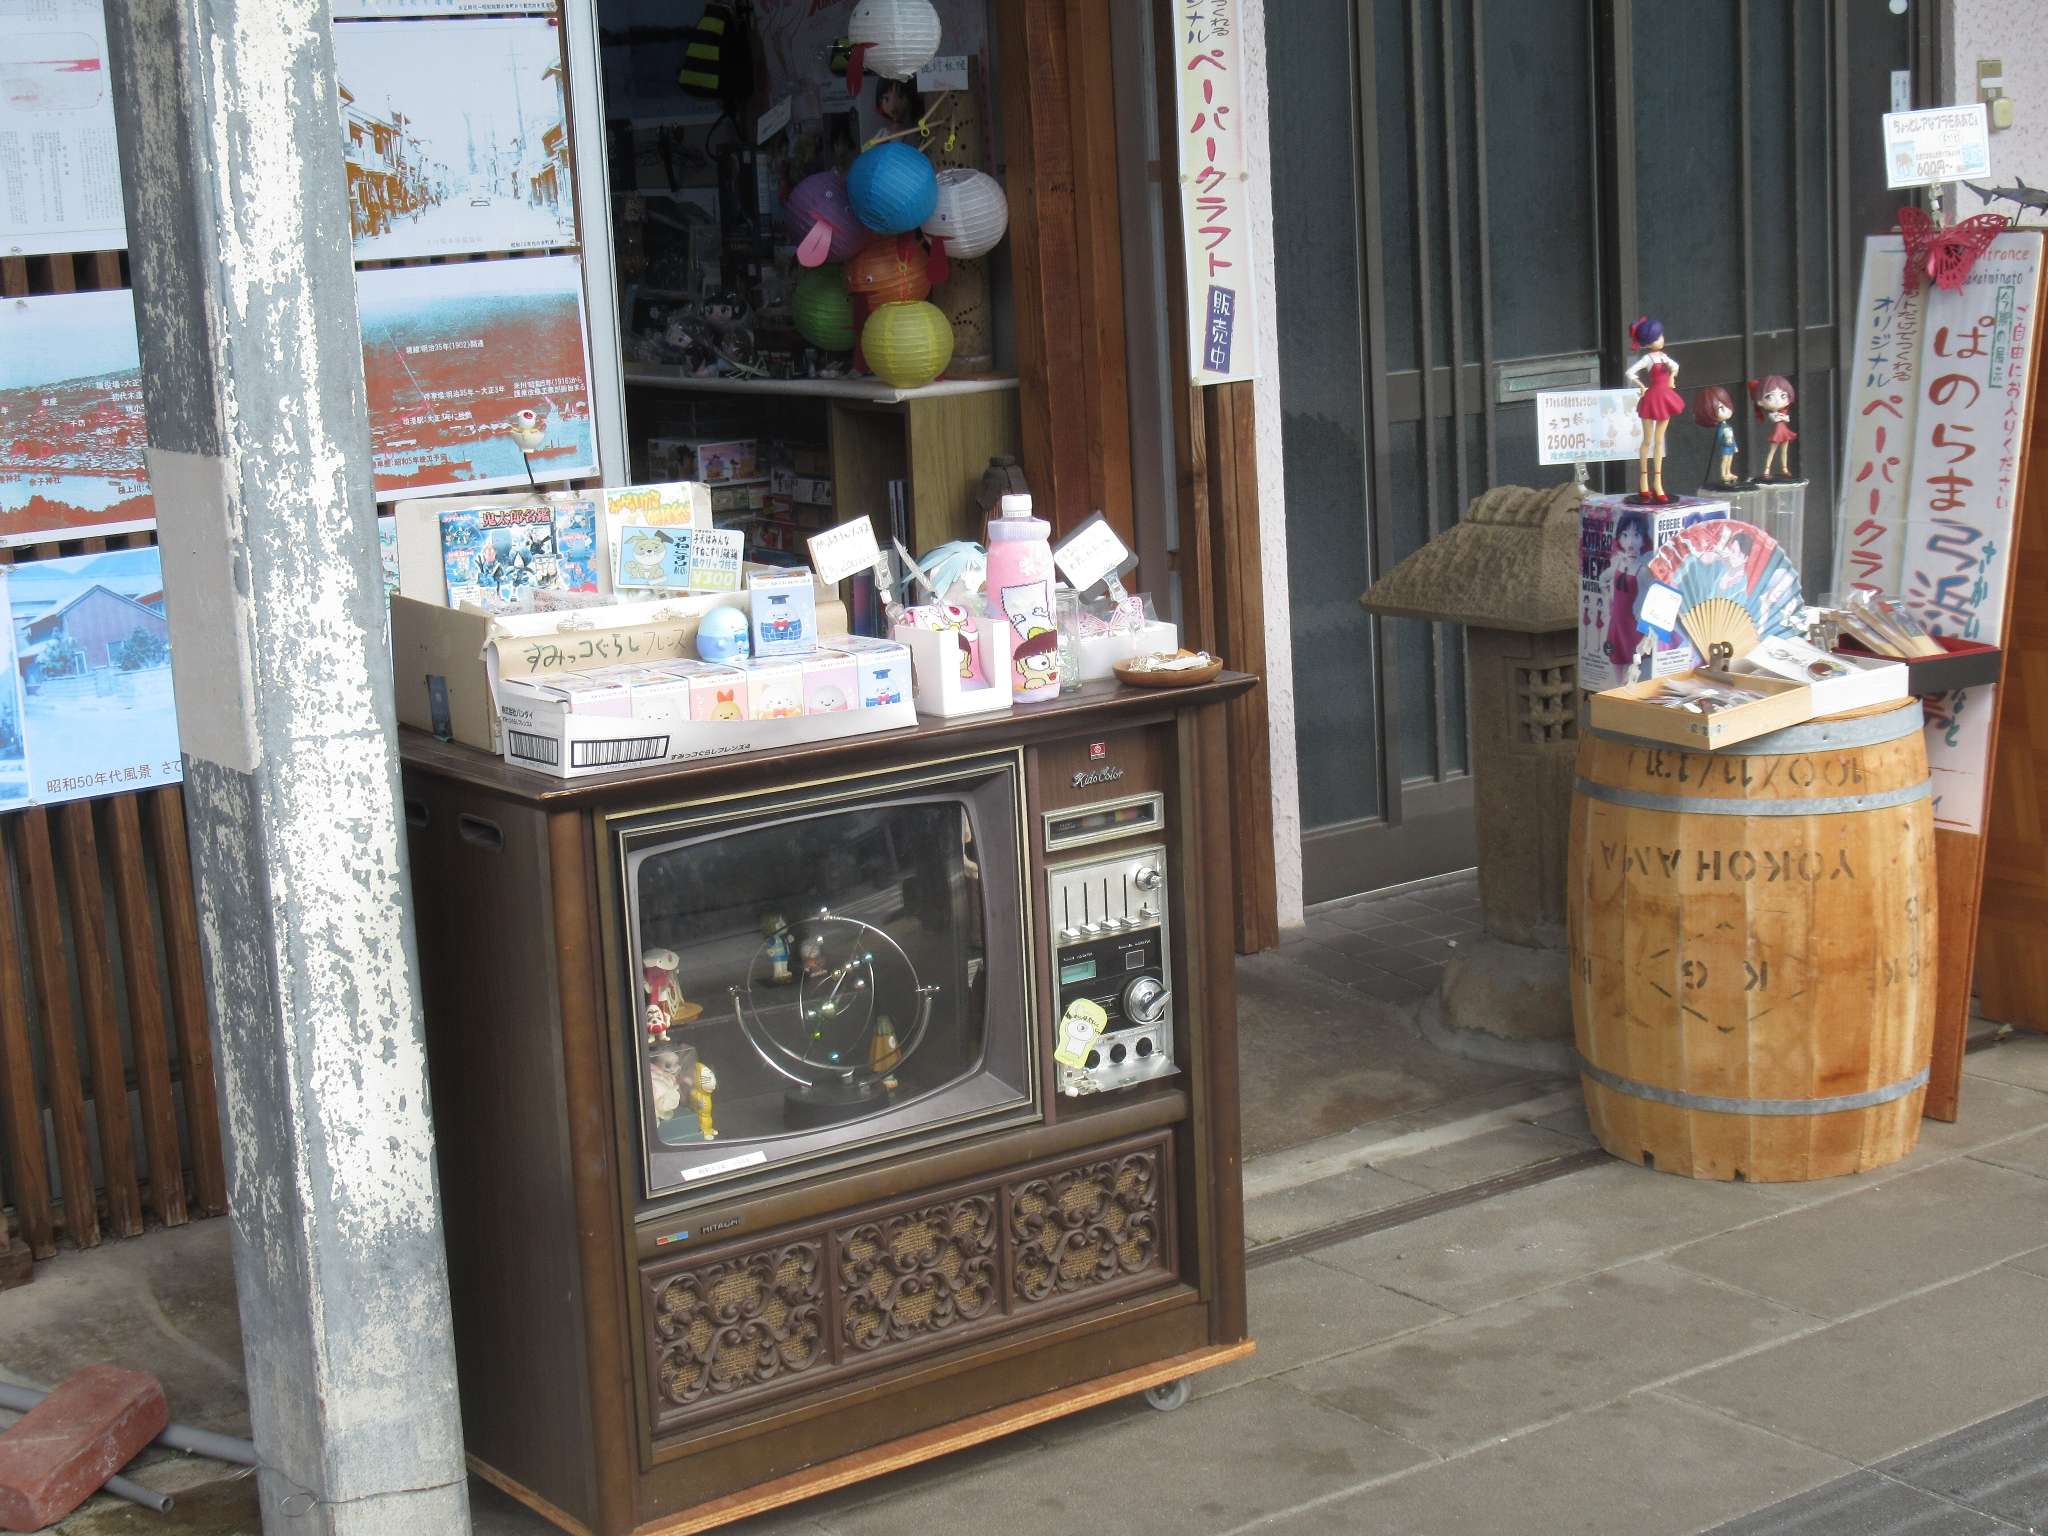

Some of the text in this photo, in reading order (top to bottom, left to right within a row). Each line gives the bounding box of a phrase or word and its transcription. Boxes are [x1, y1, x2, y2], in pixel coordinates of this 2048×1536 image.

[1187, 49, 1232, 278] ペーパークラフト
[1210, 289, 1233, 371] 販売中
[1866, 296, 1895, 388] オリジナル
[522, 633, 641, 673] すみっコぐらし
[47, 764, 152, 794] 昭和50年代風景
[1098, 765, 1125, 783] Color
[701, 1217, 741, 1235] HITACHI
